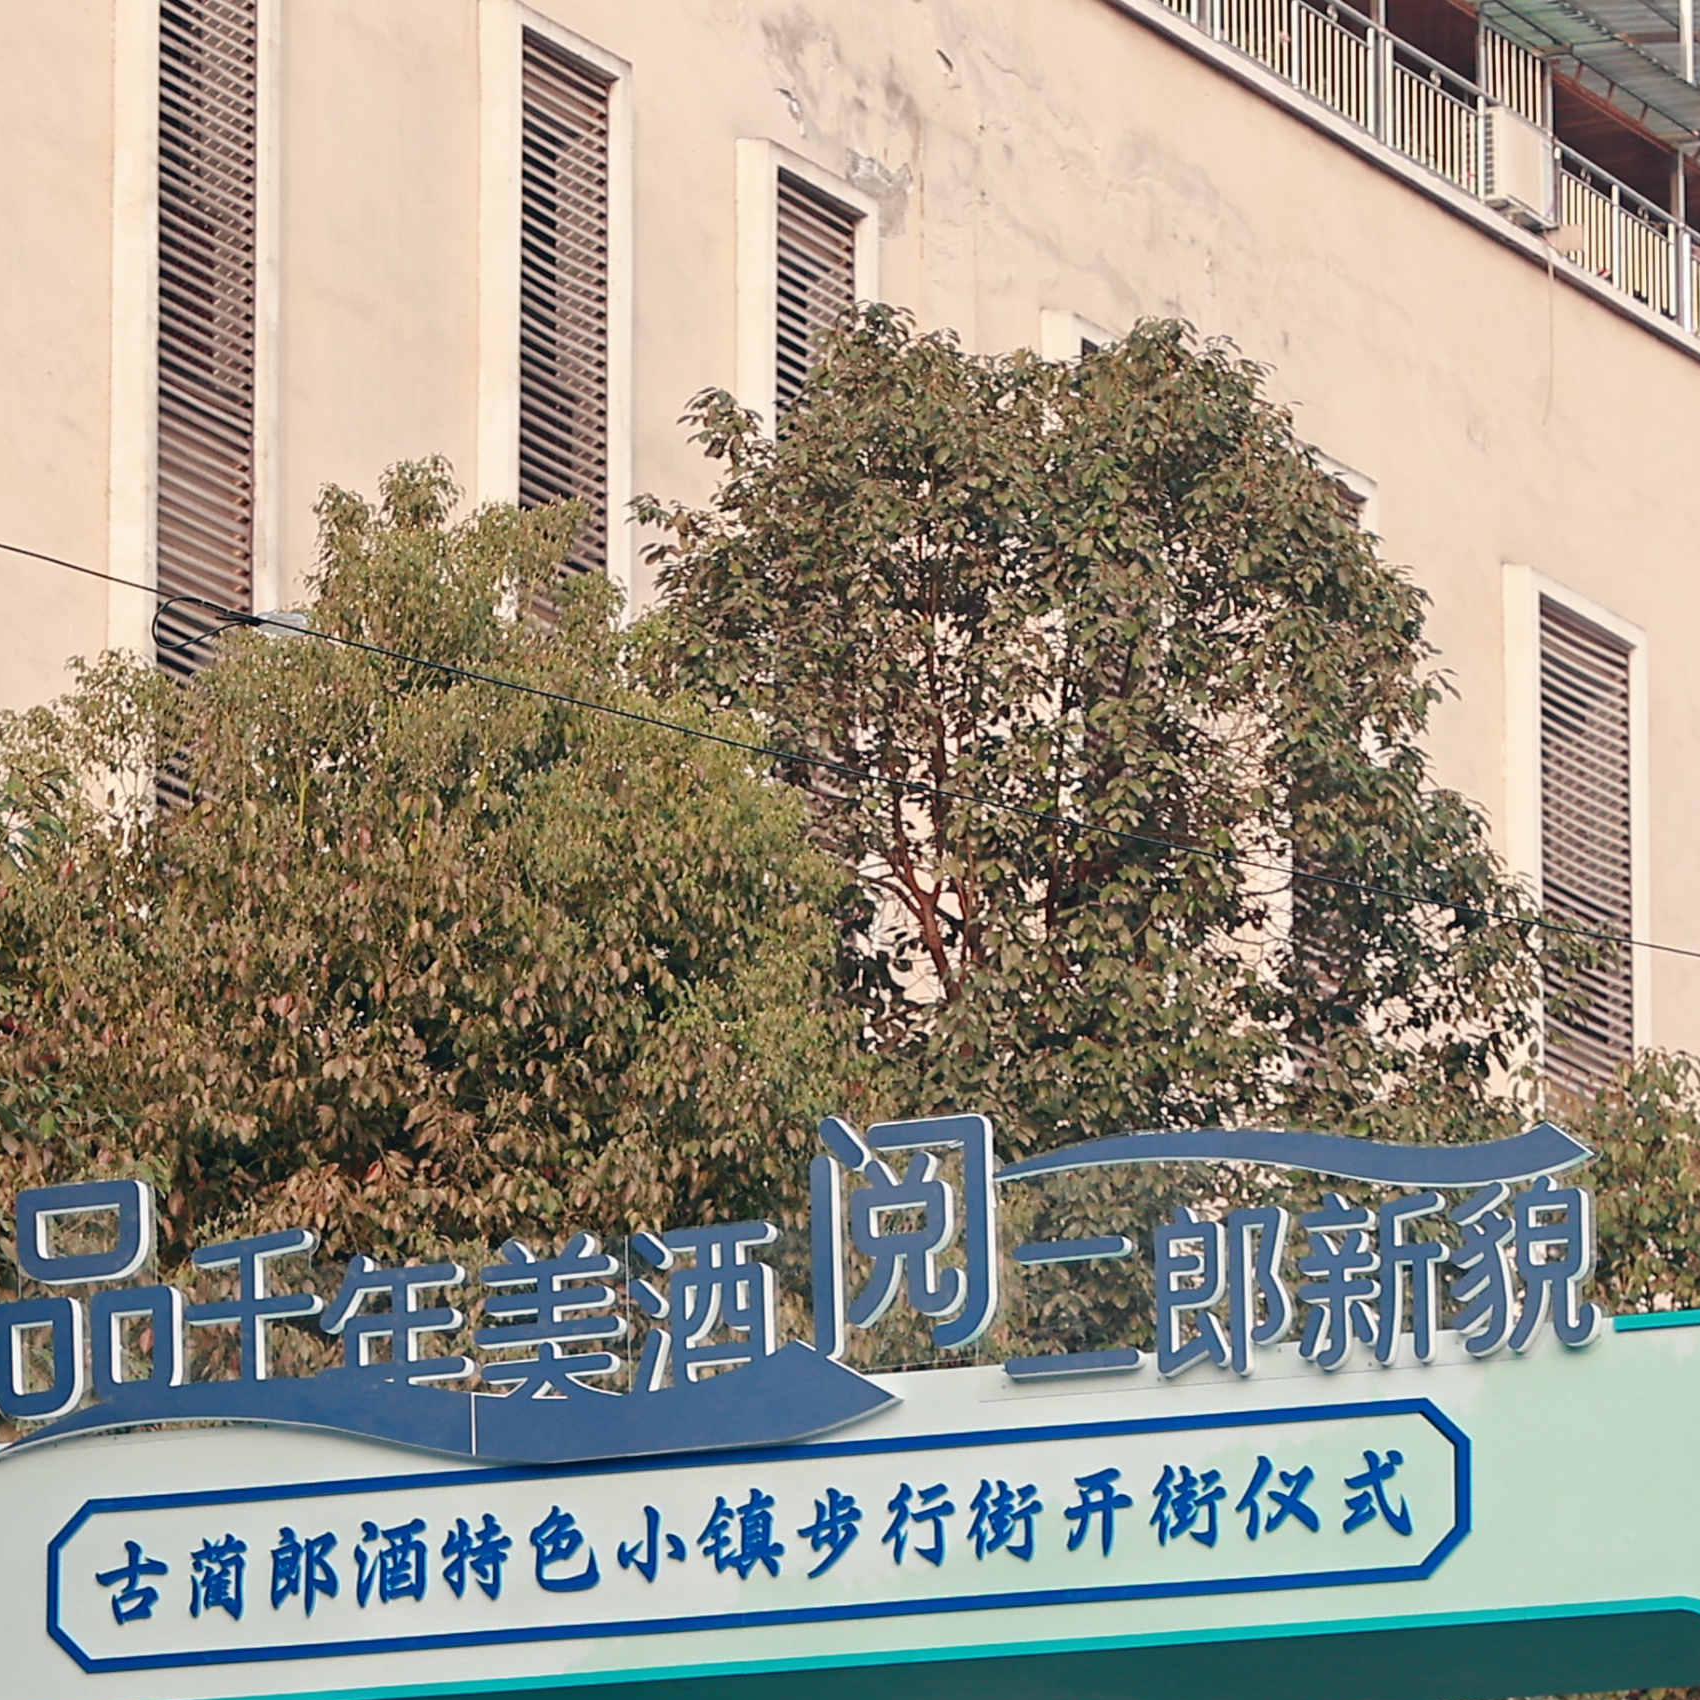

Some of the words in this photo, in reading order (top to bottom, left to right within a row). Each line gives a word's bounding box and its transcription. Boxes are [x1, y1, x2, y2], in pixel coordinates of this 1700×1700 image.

[810, 1112, 1601, 1379] 阅二郎新貌
[95, 1449, 1413, 1626] 古蔺郎酒特色小镇步行街开街仪式
